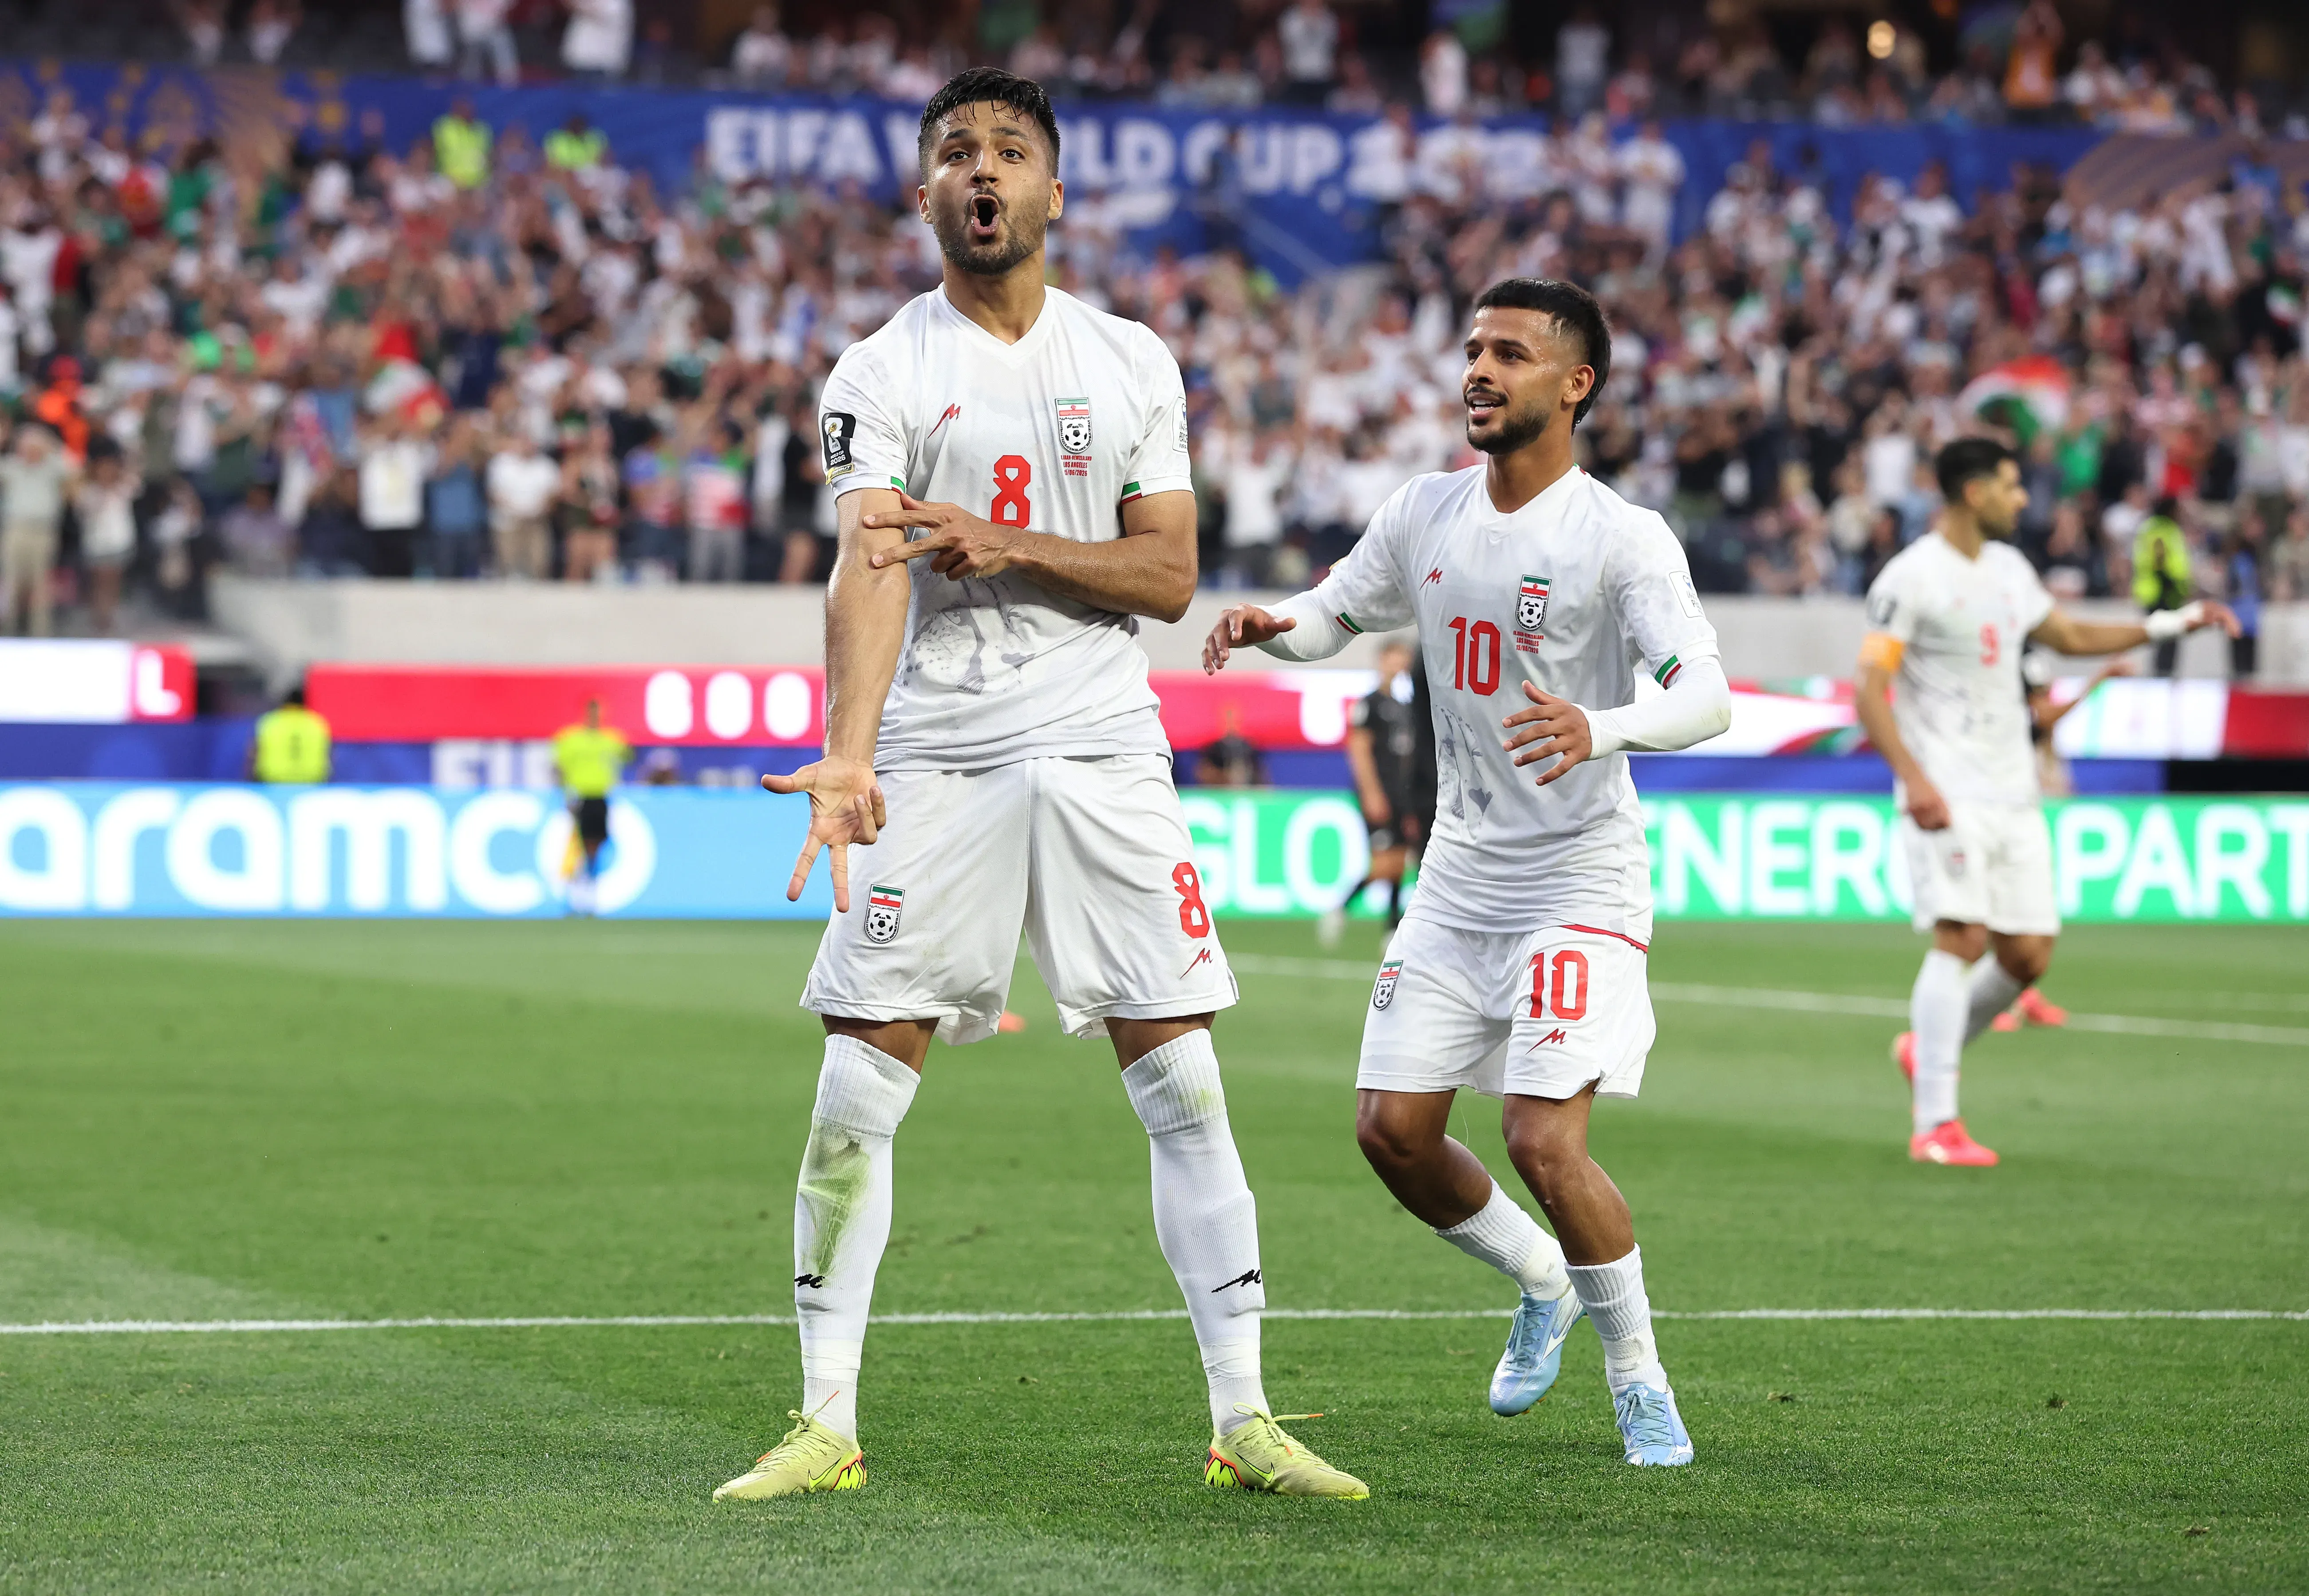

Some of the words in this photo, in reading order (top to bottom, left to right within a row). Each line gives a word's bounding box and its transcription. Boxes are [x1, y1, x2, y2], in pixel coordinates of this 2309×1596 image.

[830, 454, 846, 466] 2026
[991, 455, 1030, 530] 8
[1448, 616, 1500, 696] 10
[1979, 623, 2001, 668] 9
[0, 787, 658, 913] aramco
[1172, 862, 1210, 939] 8
[1527, 950, 1588, 1020] 10
